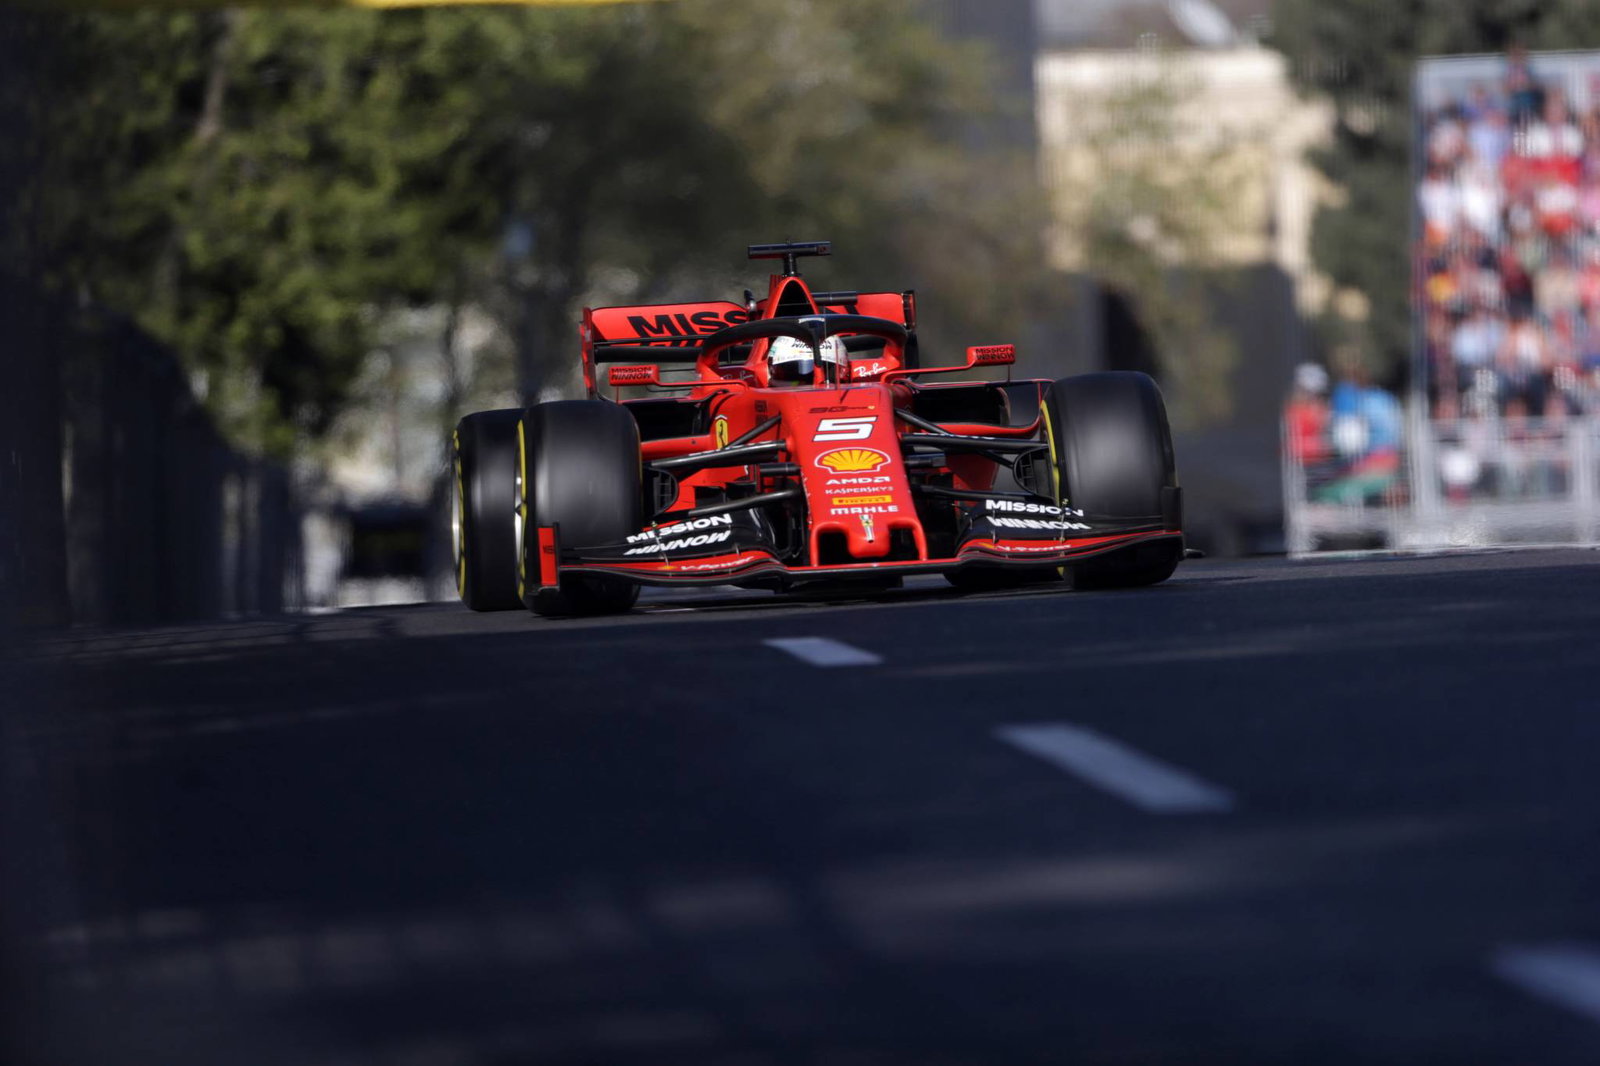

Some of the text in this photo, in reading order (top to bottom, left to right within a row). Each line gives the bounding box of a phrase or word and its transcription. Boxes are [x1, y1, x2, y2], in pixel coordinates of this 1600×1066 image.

[812, 415, 878, 442] 5
[825, 486, 887, 494] KASPERSKY
[826, 477, 873, 485] AMD
[985, 499, 1084, 517] MISSION
[626, 513, 732, 543] MISSION
[986, 516, 1092, 529] WINNOW
[623, 530, 731, 555] WINNOW
